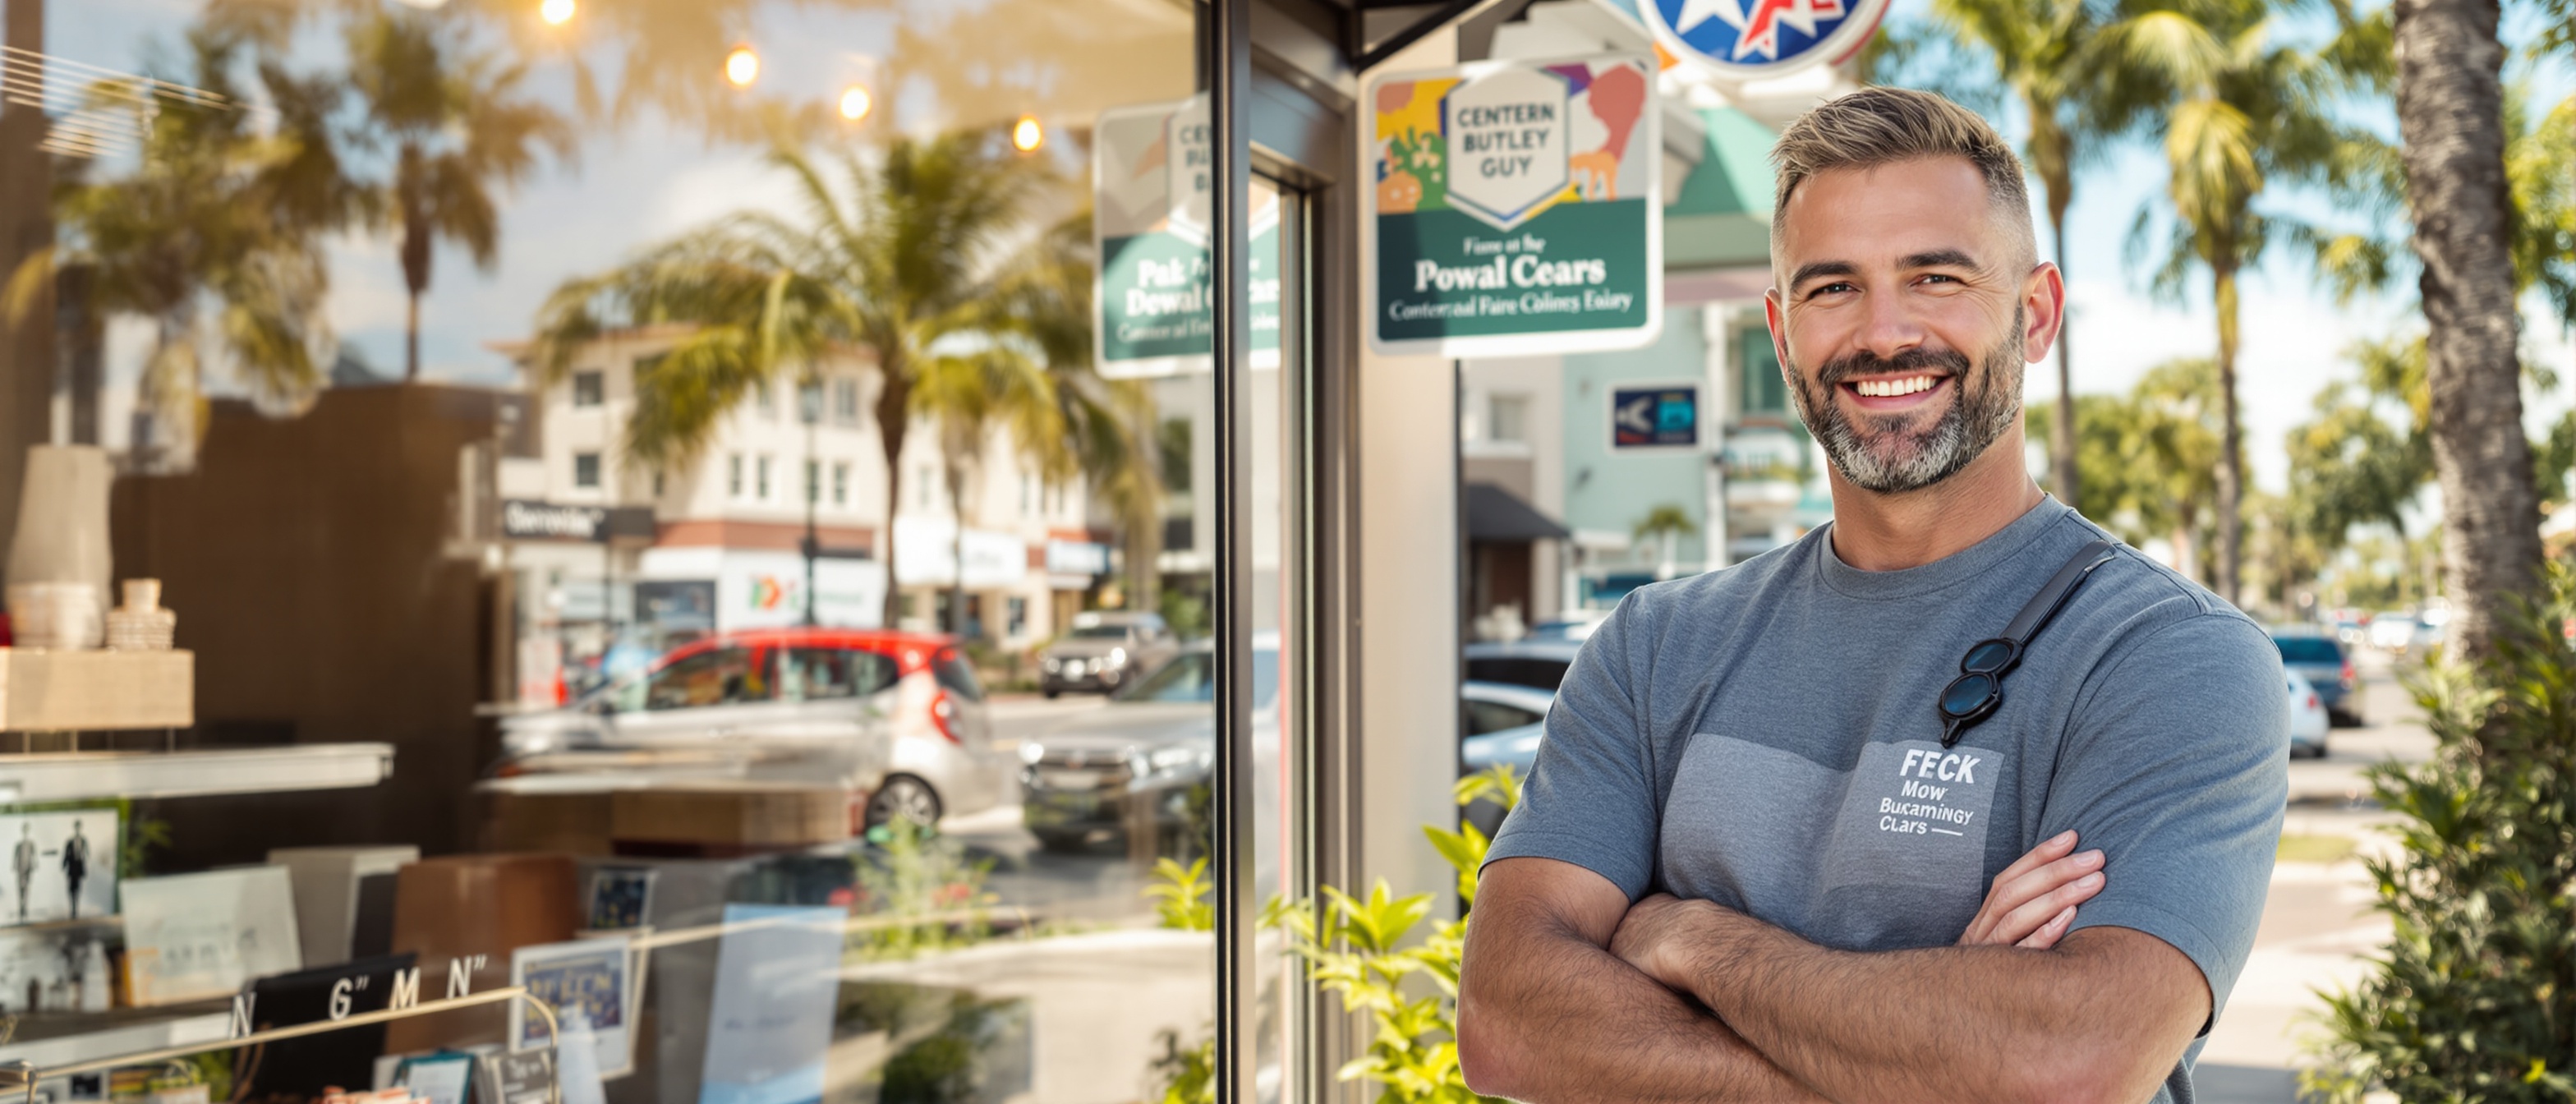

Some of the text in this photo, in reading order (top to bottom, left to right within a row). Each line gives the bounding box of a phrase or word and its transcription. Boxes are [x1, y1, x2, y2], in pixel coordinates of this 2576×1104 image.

[1457, 103, 1555, 128] CENTERN
[1464, 128, 1549, 154] BUTLEY
[1481, 155, 1533, 178] GUY
[1414, 255, 1508, 292] Powal
[1899, 748, 1981, 784] FECK
[389, 966, 421, 1011] M
